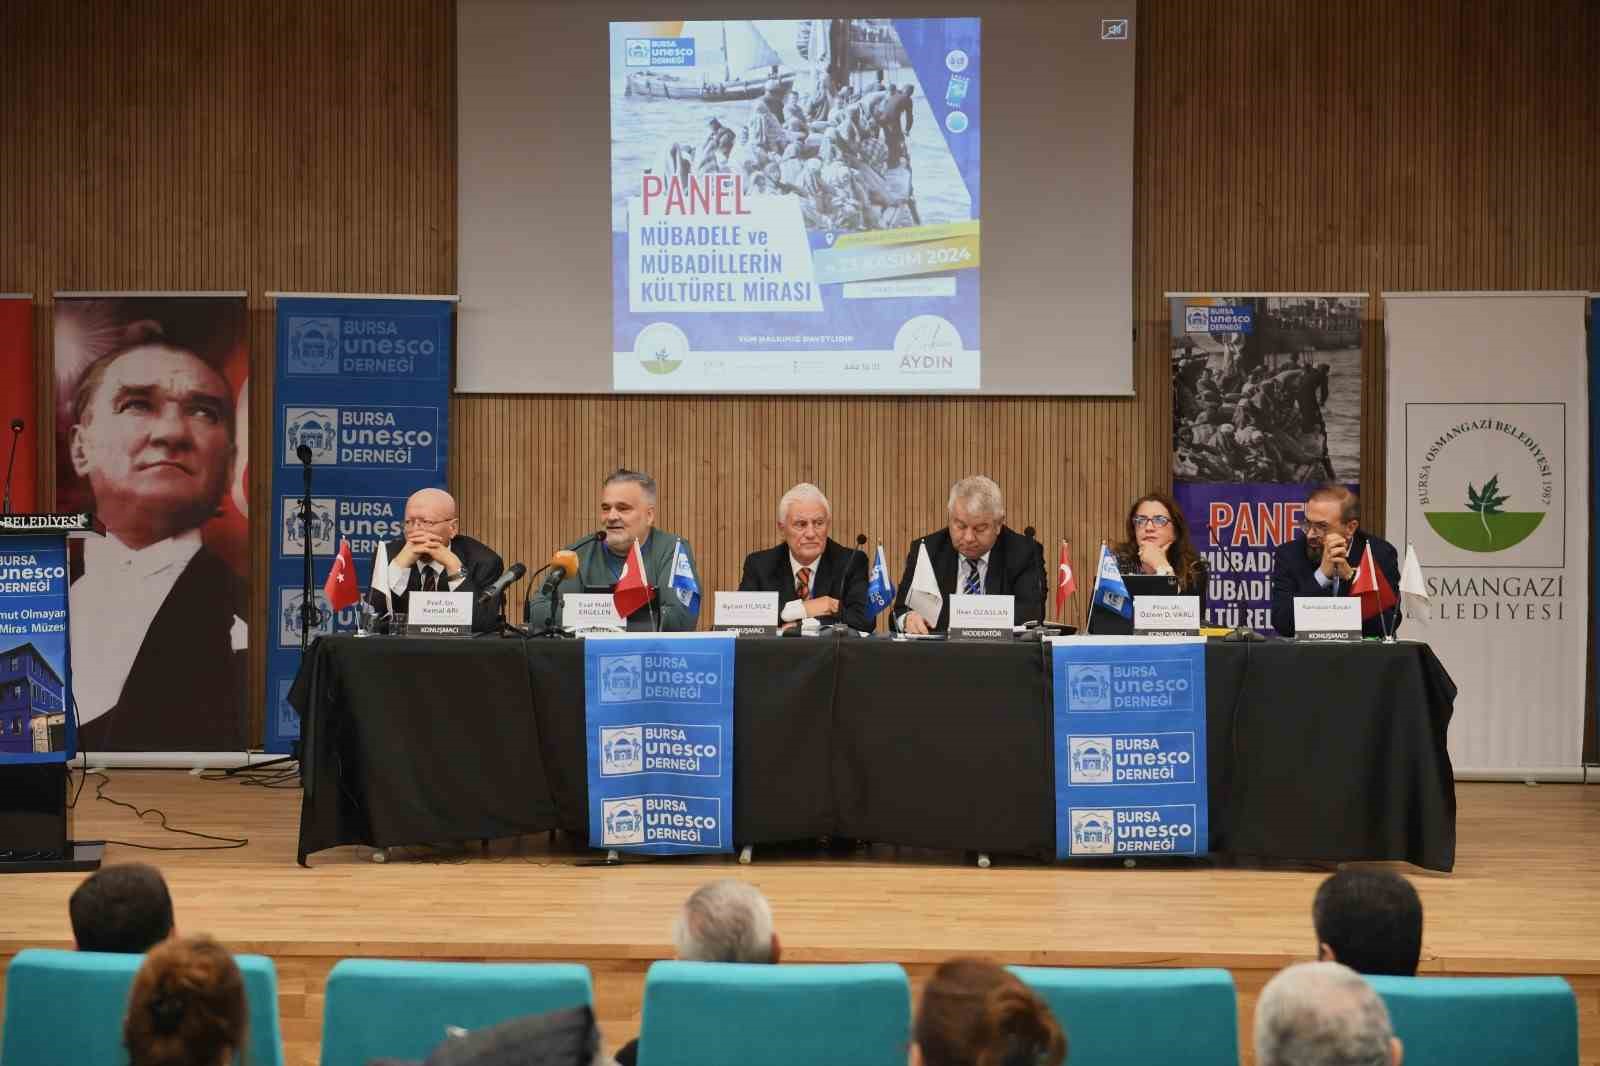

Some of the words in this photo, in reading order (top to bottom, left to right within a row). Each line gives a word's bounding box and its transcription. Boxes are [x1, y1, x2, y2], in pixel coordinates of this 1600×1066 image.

[642, 174, 752, 216] PANEL
[640, 221, 741, 246] MÜBADELE
[748, 230, 768, 246] ve
[640, 249, 783, 274] MÜBADİLLERİN
[927, 247, 972, 264] 2024
[640, 277, 737, 302] KÜLTÜREL
[743, 277, 812, 302] MİRASI
[1210, 315, 1250, 323] unesco
[344, 320, 398, 335] BURSA
[343, 338, 435, 355] unesco
[343, 357, 414, 374] DERNEĞİ
[899, 356, 953, 369] AYDIN
[342, 411, 396, 426] BURSA
[342, 428, 432, 447] unesco
[341, 447, 412, 464] DERNEĞİ
[1417, 464, 1431, 504] BURSA
[1425, 418, 1492, 462] OSMANGAZİ
[1496, 420, 1552, 476] BELEDİYESİ
[340, 502, 393, 517] BURSA
[3, 514, 83, 528] BELEDİYESİ
[339, 520, 404, 536] unes
[1209, 502, 1305, 546] PANE
[1427, 575, 1563, 597] SMANGAZİ
[0, 611, 18, 619] mut
[21, 609, 66, 620] Olmayan
[645, 656, 688, 669] BURSA
[644, 672, 718, 685] unesco
[1113, 666, 1158, 678] BURSA
[645, 686, 701, 698] DERNEĞİ
[1114, 679, 1189, 693] unesco
[1114, 692, 1173, 708] DERNEĞİ
[646, 728, 687, 741] BURSA
[645, 743, 717, 758] unesco
[1115, 739, 1159, 750] BURSA
[646, 757, 700, 771] DERNEĞİ
[1116, 752, 1190, 766] unesco
[1116, 765, 1174, 780] DERNEĞİ
[646, 800, 688, 813] BURSA
[646, 815, 716, 830] unesco
[1116, 812, 1161, 823] BURSA
[647, 828, 701, 842] DERNEĞİ
[1117, 825, 1191, 839] unesco
[1117, 837, 1175, 851] DERNEĞİ
